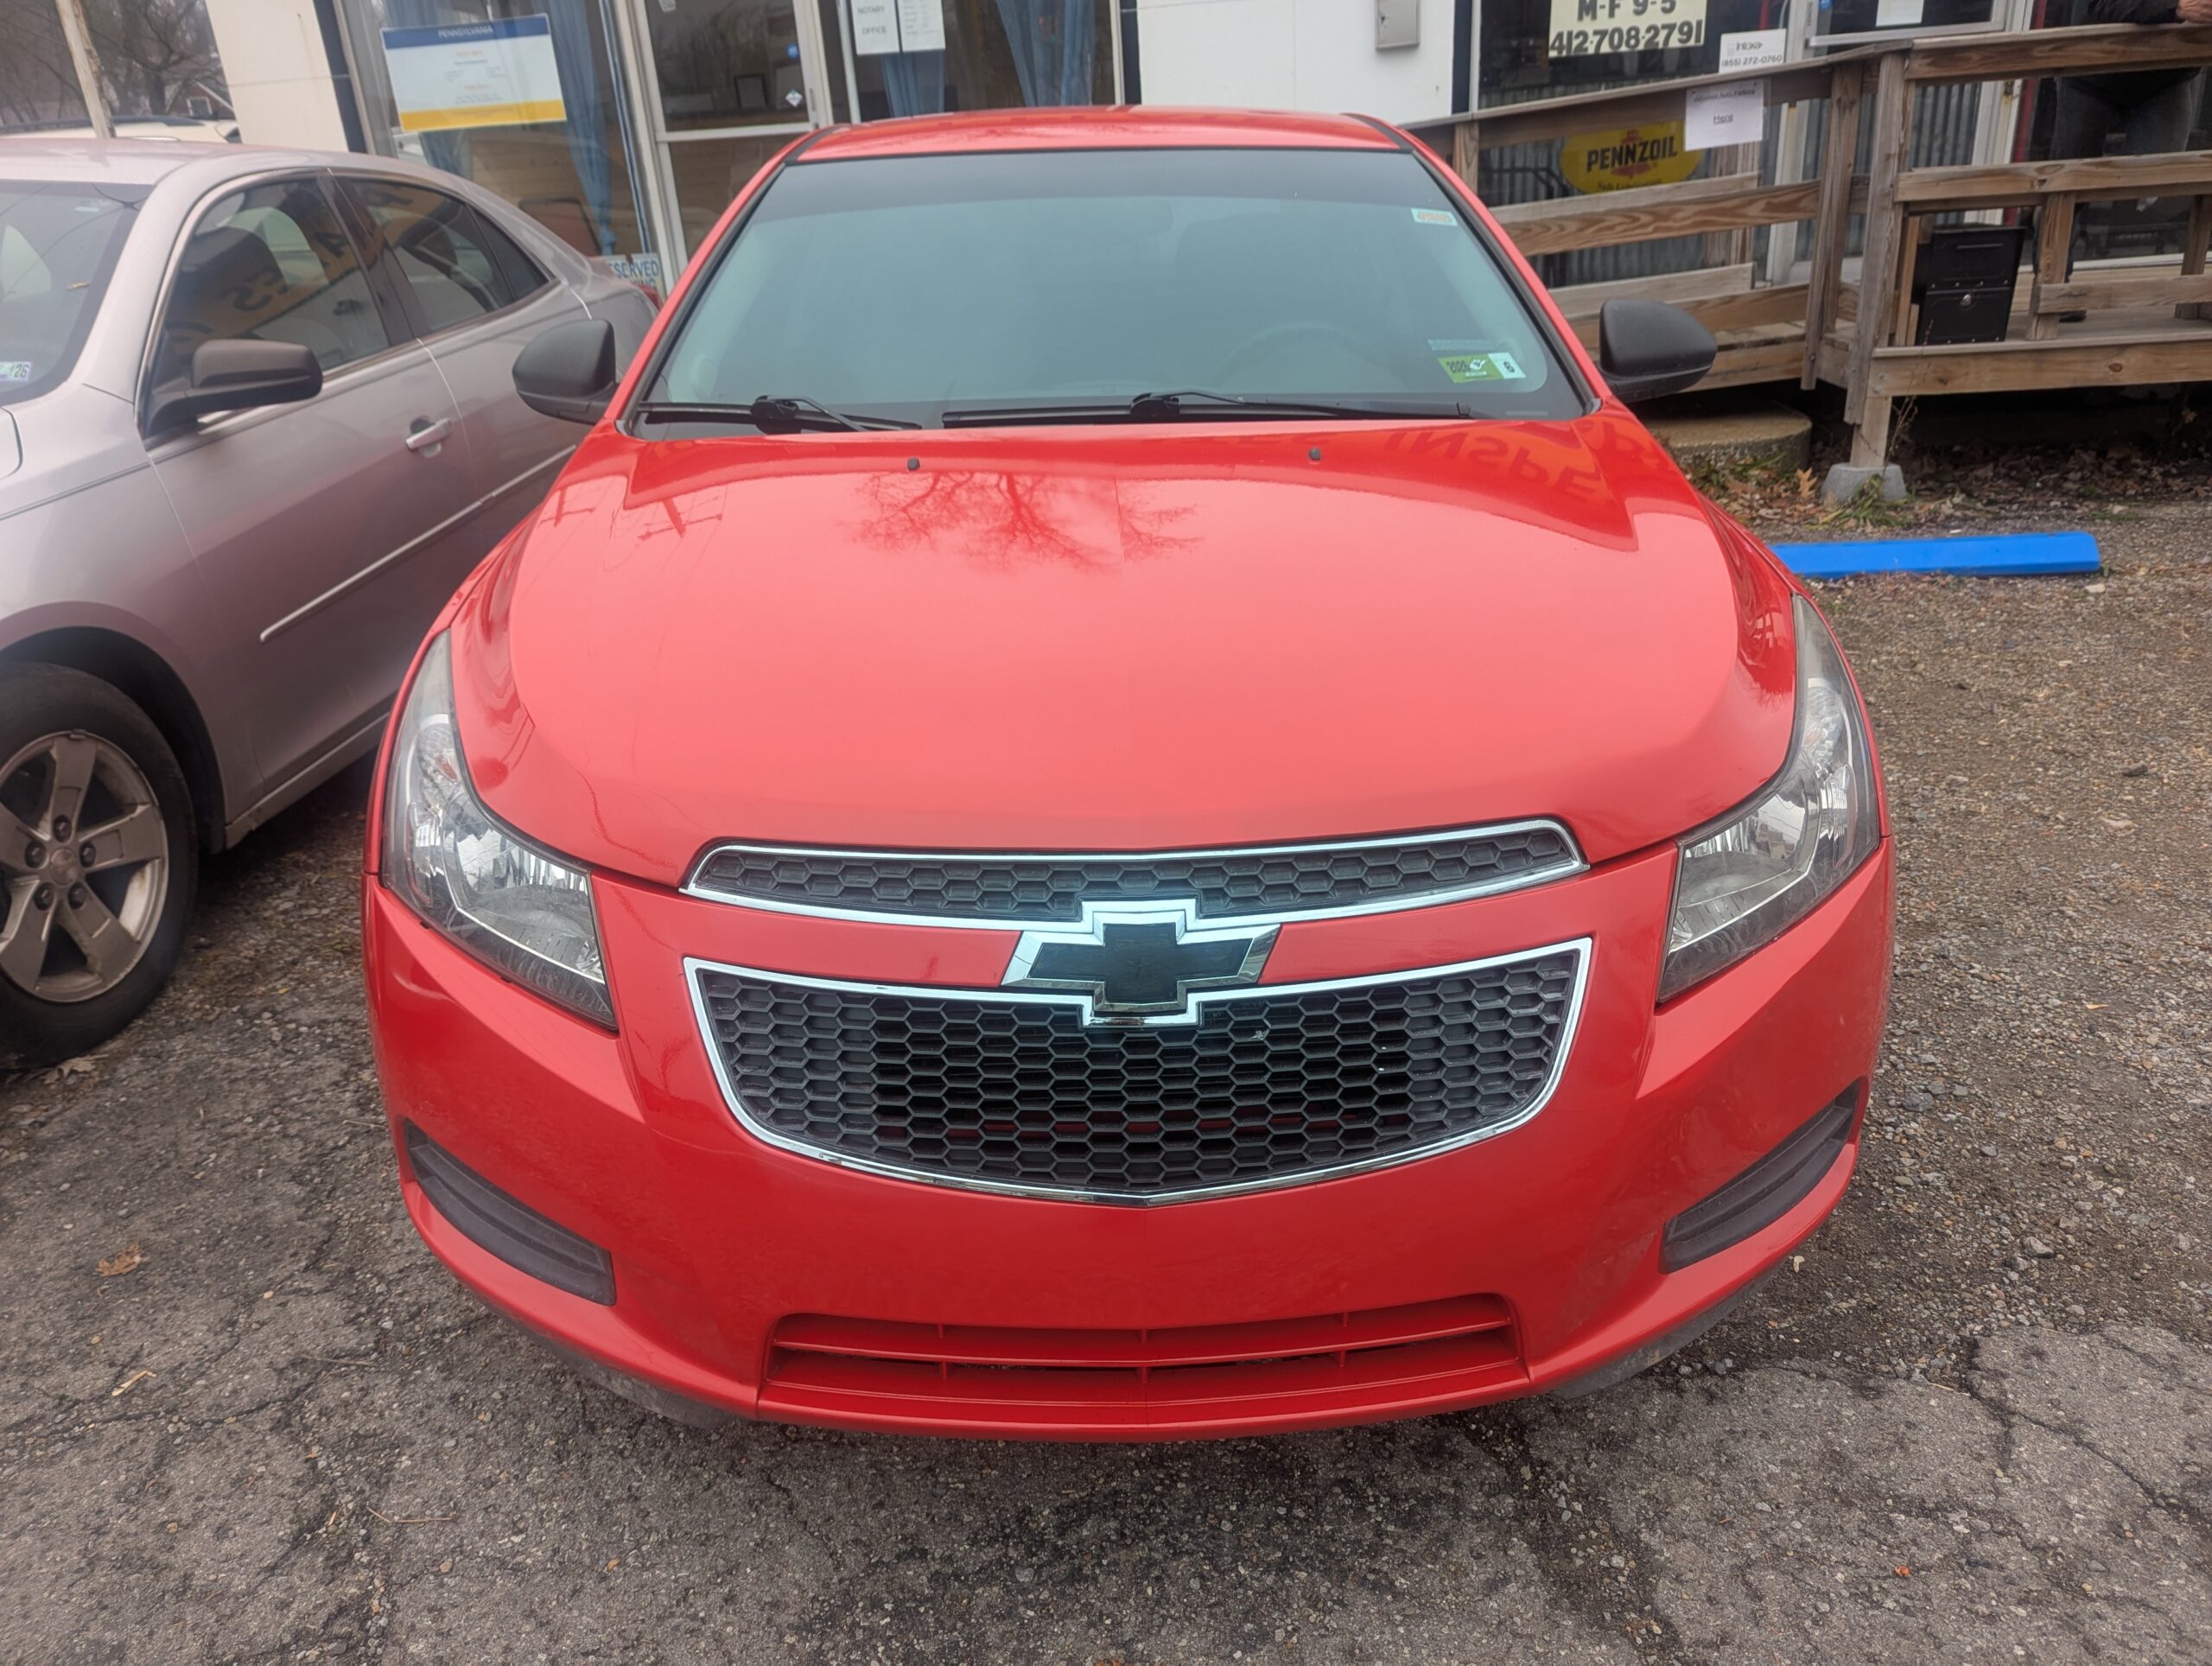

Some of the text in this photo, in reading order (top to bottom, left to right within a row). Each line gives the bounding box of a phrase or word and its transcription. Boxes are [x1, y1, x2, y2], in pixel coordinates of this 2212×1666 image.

[857, 6, 885, 15] NOTARY
[1577, 0, 1621, 22] M-F
[861, 26, 887, 35] OFFICE
[1742, 54, 1782, 66] 272-0760
[1713, 114, 1734, 124] Here
[1586, 137, 1678, 172] PENNZOIL
